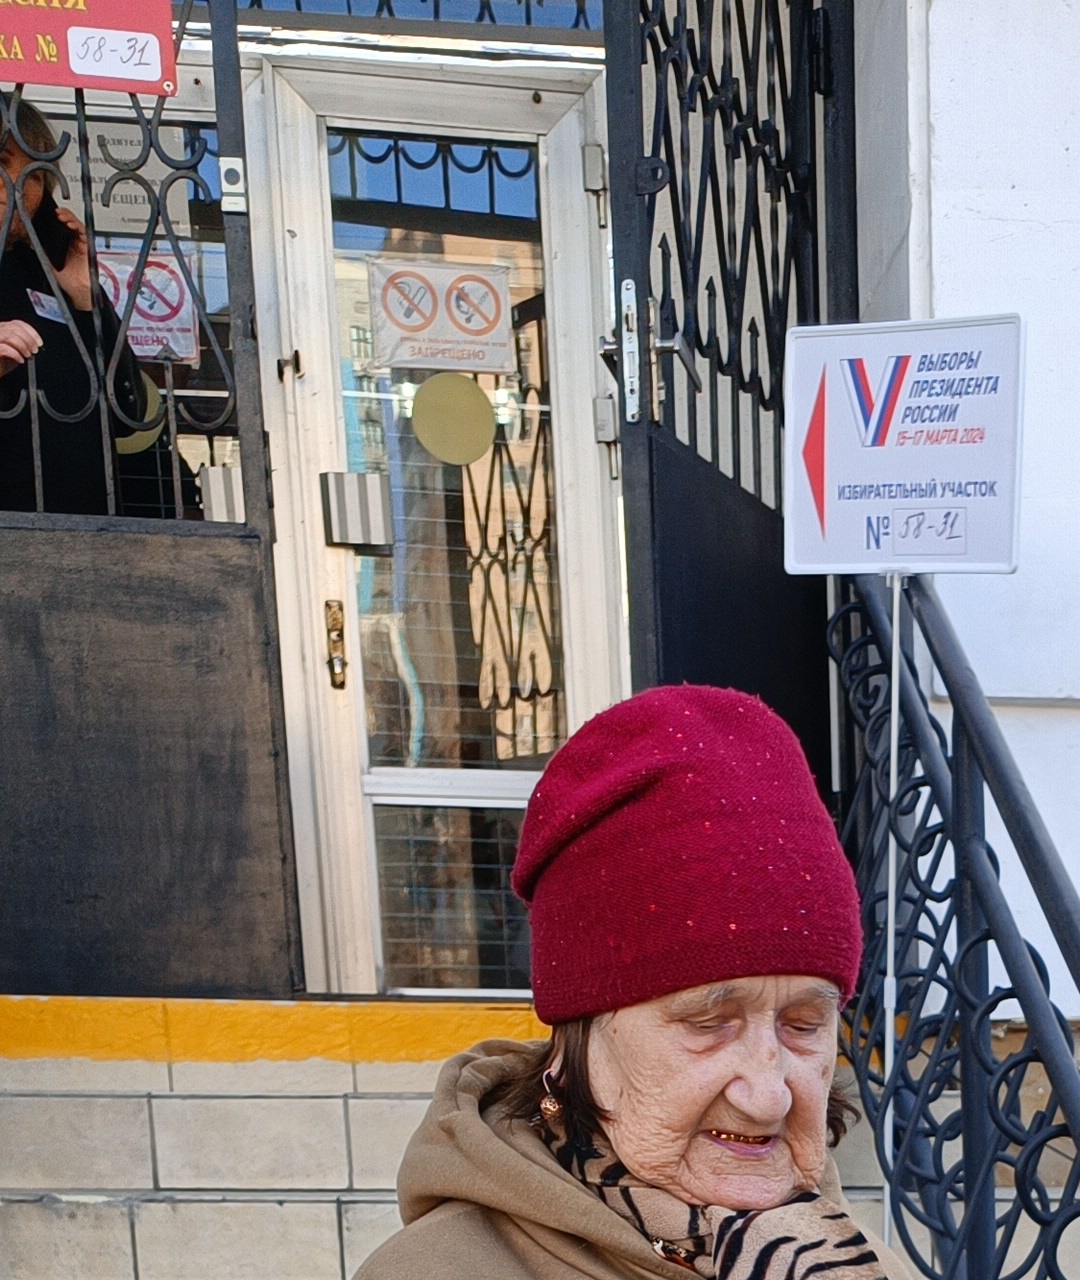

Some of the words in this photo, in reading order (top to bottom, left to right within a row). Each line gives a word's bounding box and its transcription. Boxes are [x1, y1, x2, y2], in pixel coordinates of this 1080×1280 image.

[35, 33, 58, 62] №
[76, 35, 152, 66] 58-31
[916, 351, 982, 373] ВЫБОРЫ
[908, 375, 1000, 399] ПРЕЗИДЕНТА
[901, 403, 960, 424] РОССИИ
[925, 428, 958, 446] МАРТА
[960, 427, 986, 444] 2024
[837, 478, 937, 500] ИЗБИРАТЕЛЬНЫЙ
[940, 480, 998, 498] УЧАСТОК
[866, 515, 890, 550] №
[900, 511, 963, 540] 58-31
